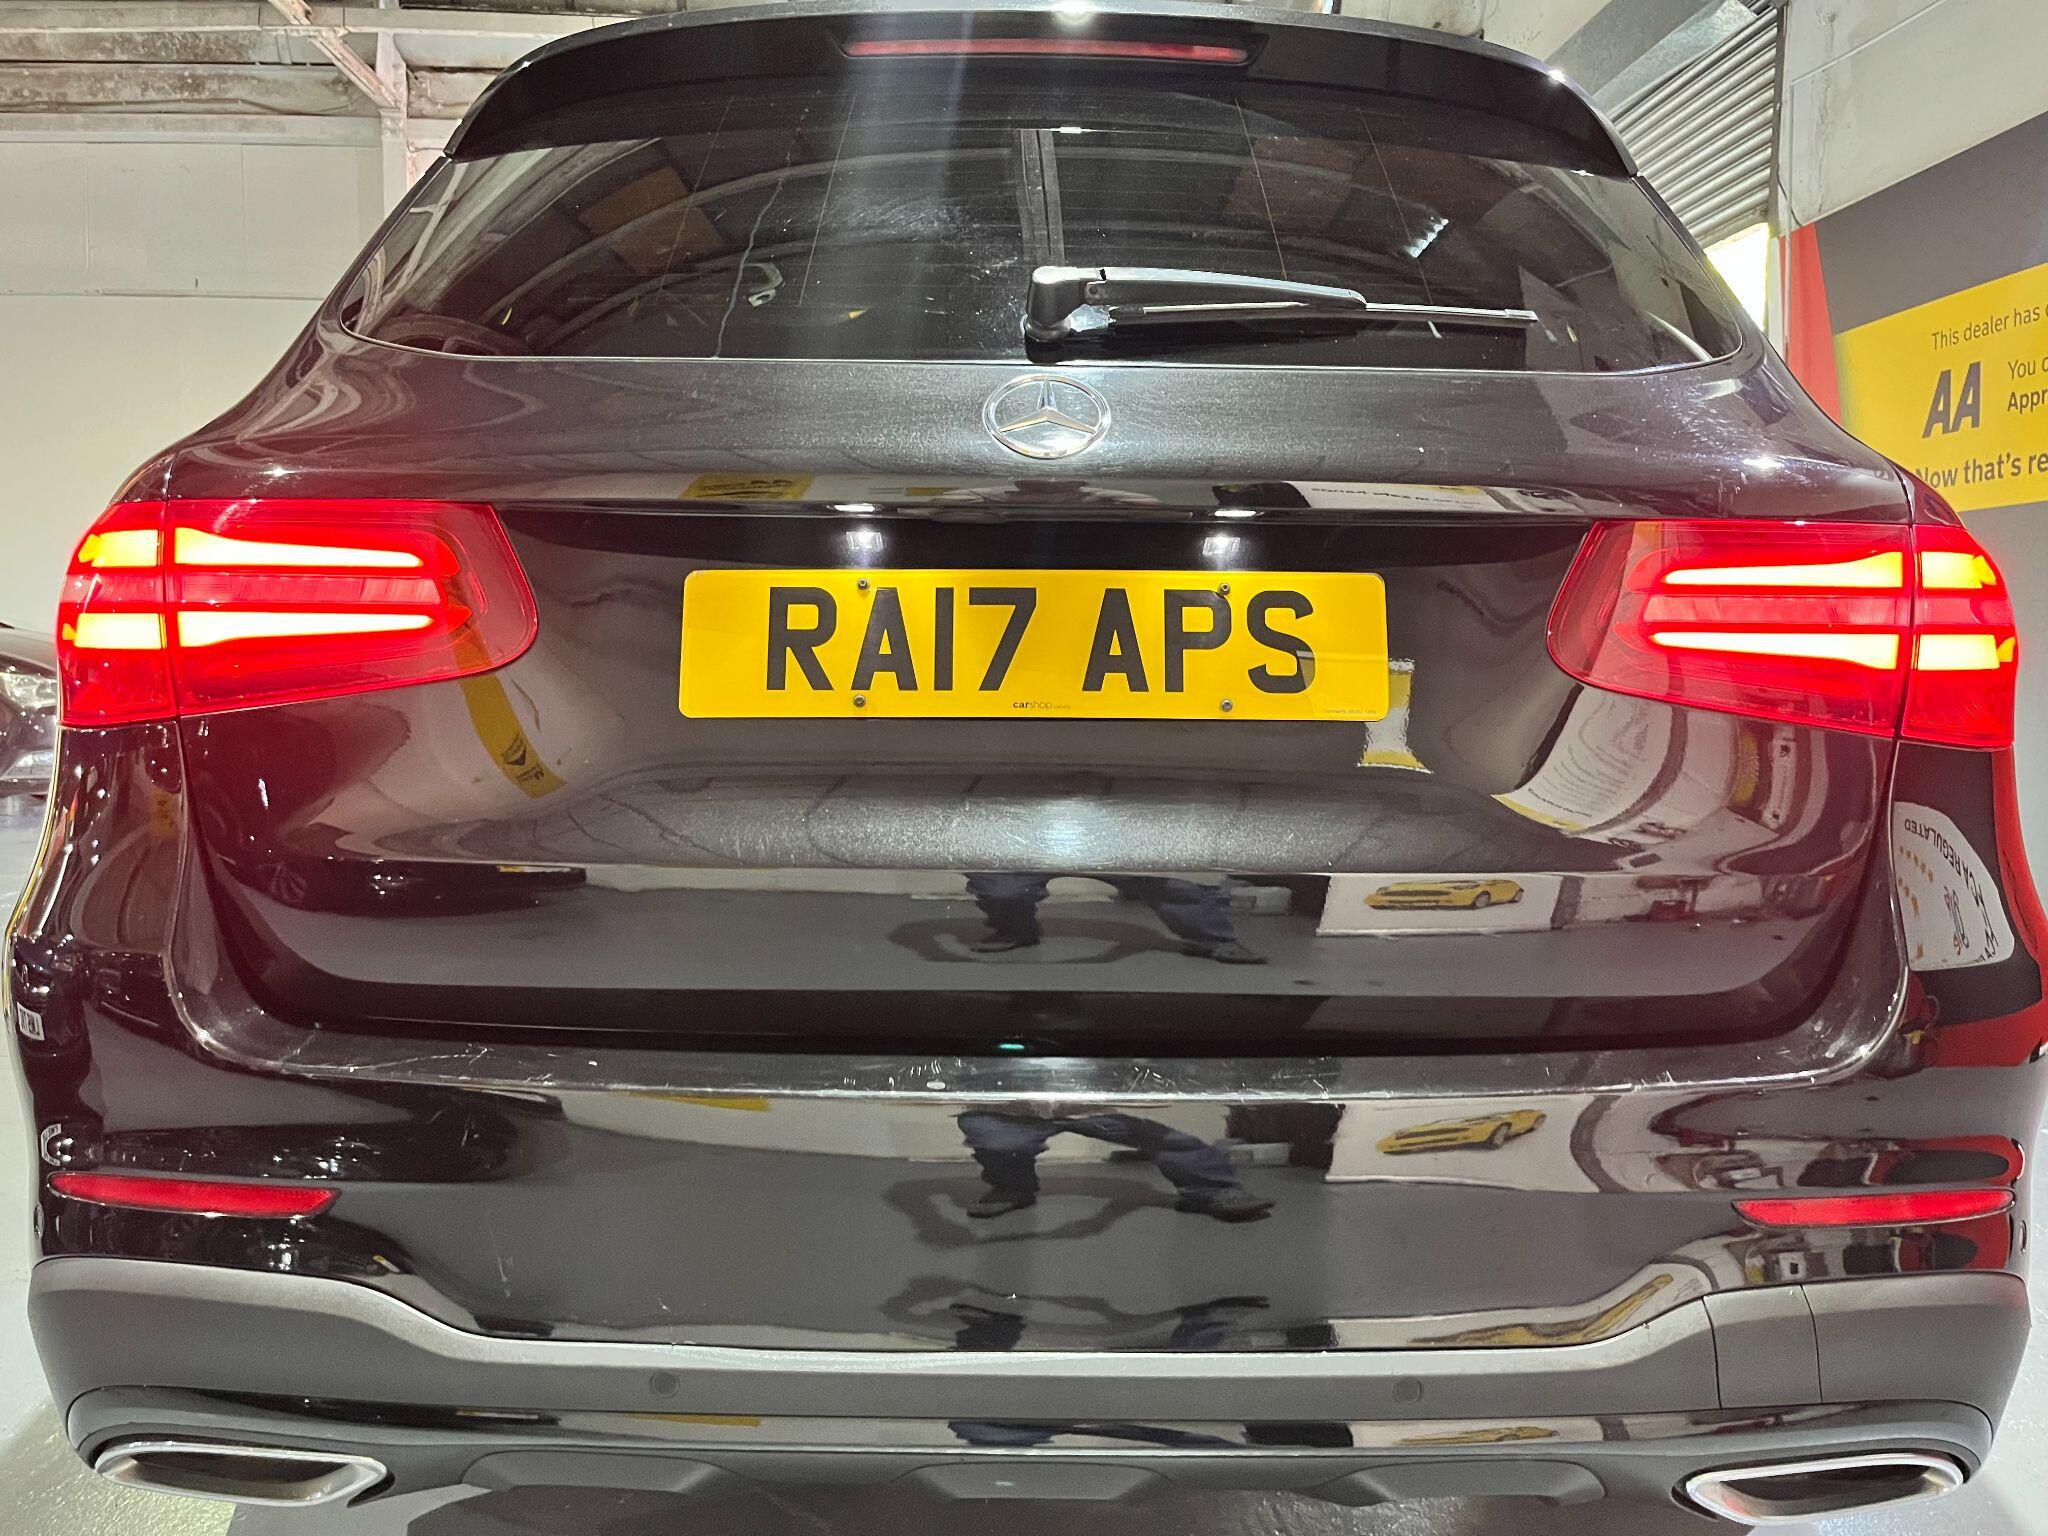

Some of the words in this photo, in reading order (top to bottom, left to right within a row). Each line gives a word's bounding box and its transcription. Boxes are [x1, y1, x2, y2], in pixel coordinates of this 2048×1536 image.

[1931, 328, 1959, 350] This
[1963, 315, 2010, 341] dealer
[2013, 306, 2040, 328] has
[2007, 359, 2036, 380] You
[1922, 361, 1981, 439] AA
[1963, 452, 2021, 484] that's
[766, 586, 1037, 691] RA17
[1082, 587, 1316, 694] APS
[1013, 700, 1053, 710] carshop
